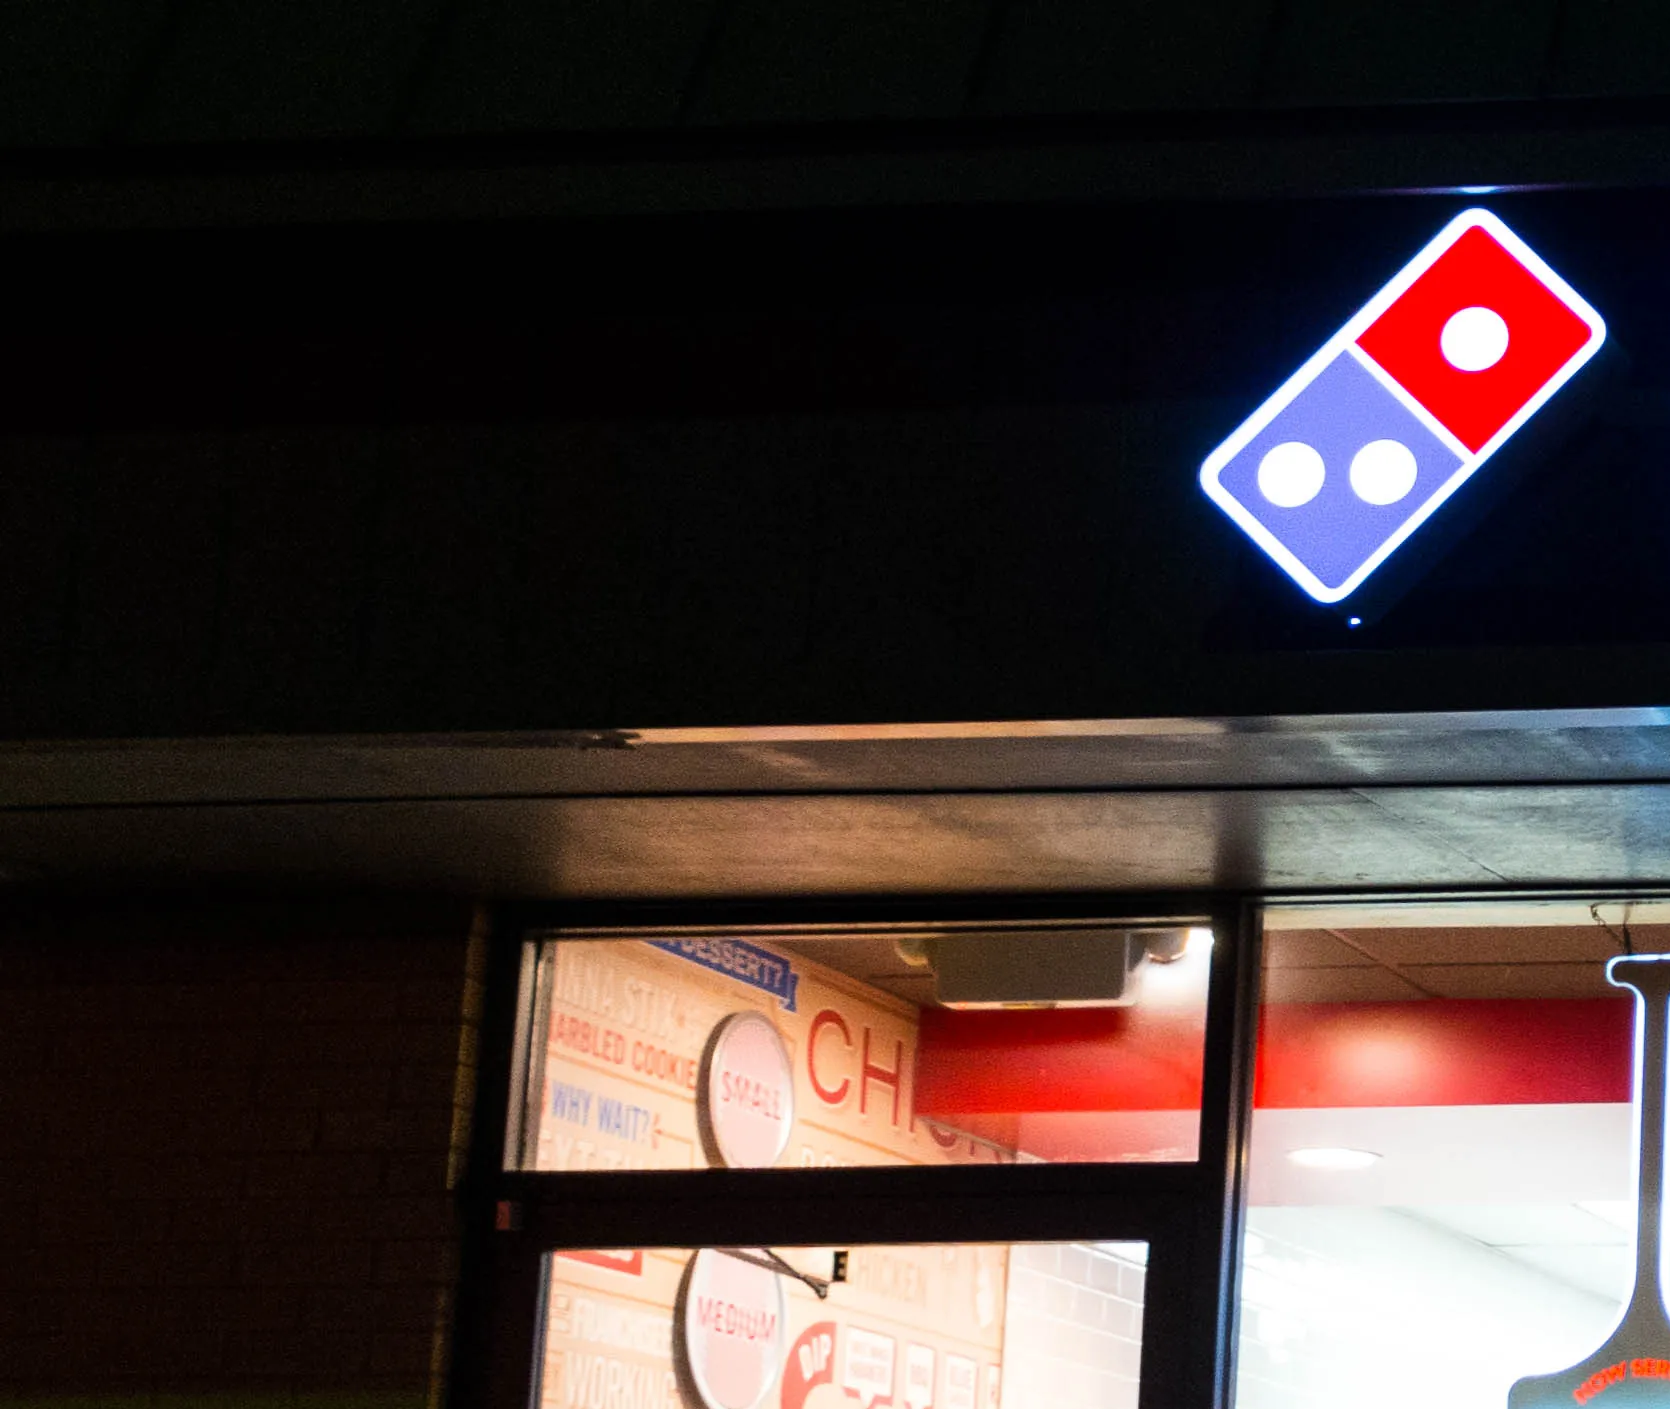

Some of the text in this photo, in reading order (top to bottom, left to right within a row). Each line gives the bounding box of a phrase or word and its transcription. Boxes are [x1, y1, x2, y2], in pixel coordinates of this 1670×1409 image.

[551, 1010, 626, 1066] ARBLED
[721, 1071, 781, 1121] SMALL
[697, 1295, 777, 1342] MEDIUM
[799, 1334, 831, 1380] DIP
[1572, 1359, 1627, 1406] NOW
